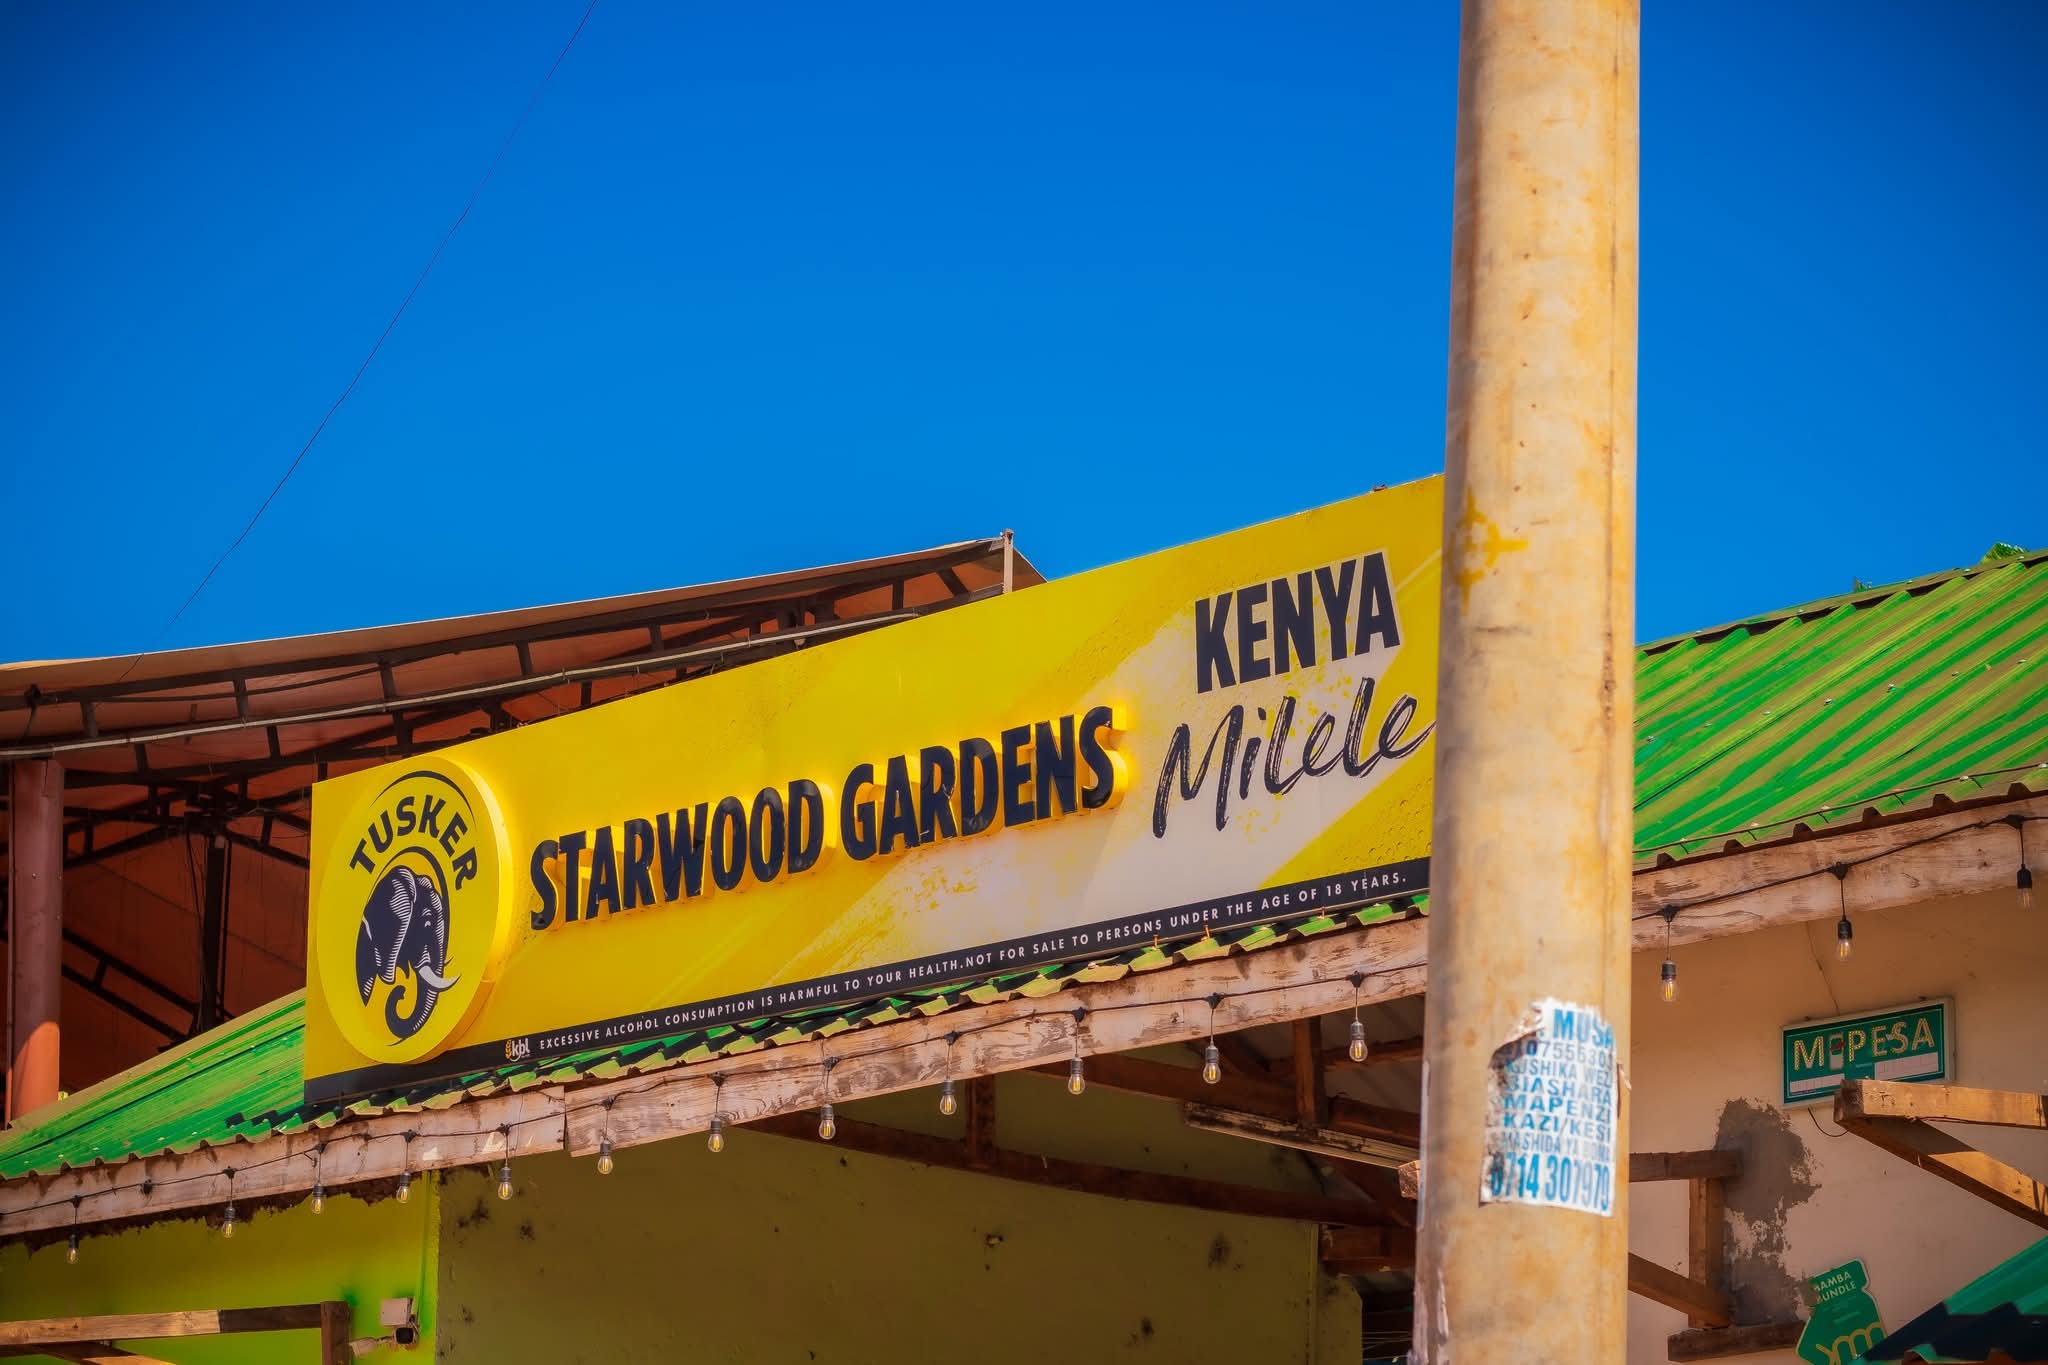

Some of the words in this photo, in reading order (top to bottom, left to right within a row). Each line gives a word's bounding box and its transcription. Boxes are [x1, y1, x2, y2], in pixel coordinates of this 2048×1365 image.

[1195, 552, 1400, 694] KENYA
[530, 778, 825, 931] STARWOOD
[840, 705, 1117, 862] GARDENS
[1152, 677, 1437, 838] Milele
[349, 794, 478, 891] TUSKER
[540, 1029, 600, 1050] EXCESSIVE
[605, 1017, 659, 1037] ALCOHOL
[665, 999, 754, 1025] CONSUMPTION
[761, 996, 773, 1007] IS
[779, 983, 839, 1003] HARMFUL
[845, 978, 860, 990] TO
[867, 970, 902, 987] YOUR
[1000, 947, 1025, 961] FOR
[1033, 938, 1065, 954] SALE
[1072, 934, 1089, 947] TO
[1097, 919, 1163, 942] PERSONS
[1170, 908, 1219, 928] UNDER
[1226, 901, 1253, 917] THE
[1261, 893, 1291, 910] AGE
[1298, 888, 1319, 903] OF
[1326, 883, 1342, 897] 18
[1351, 871, 1407, 892] YEARS.
[511, 1037, 530, 1060] kbl
[1504, 1094, 1611, 1124] MAPENZI
